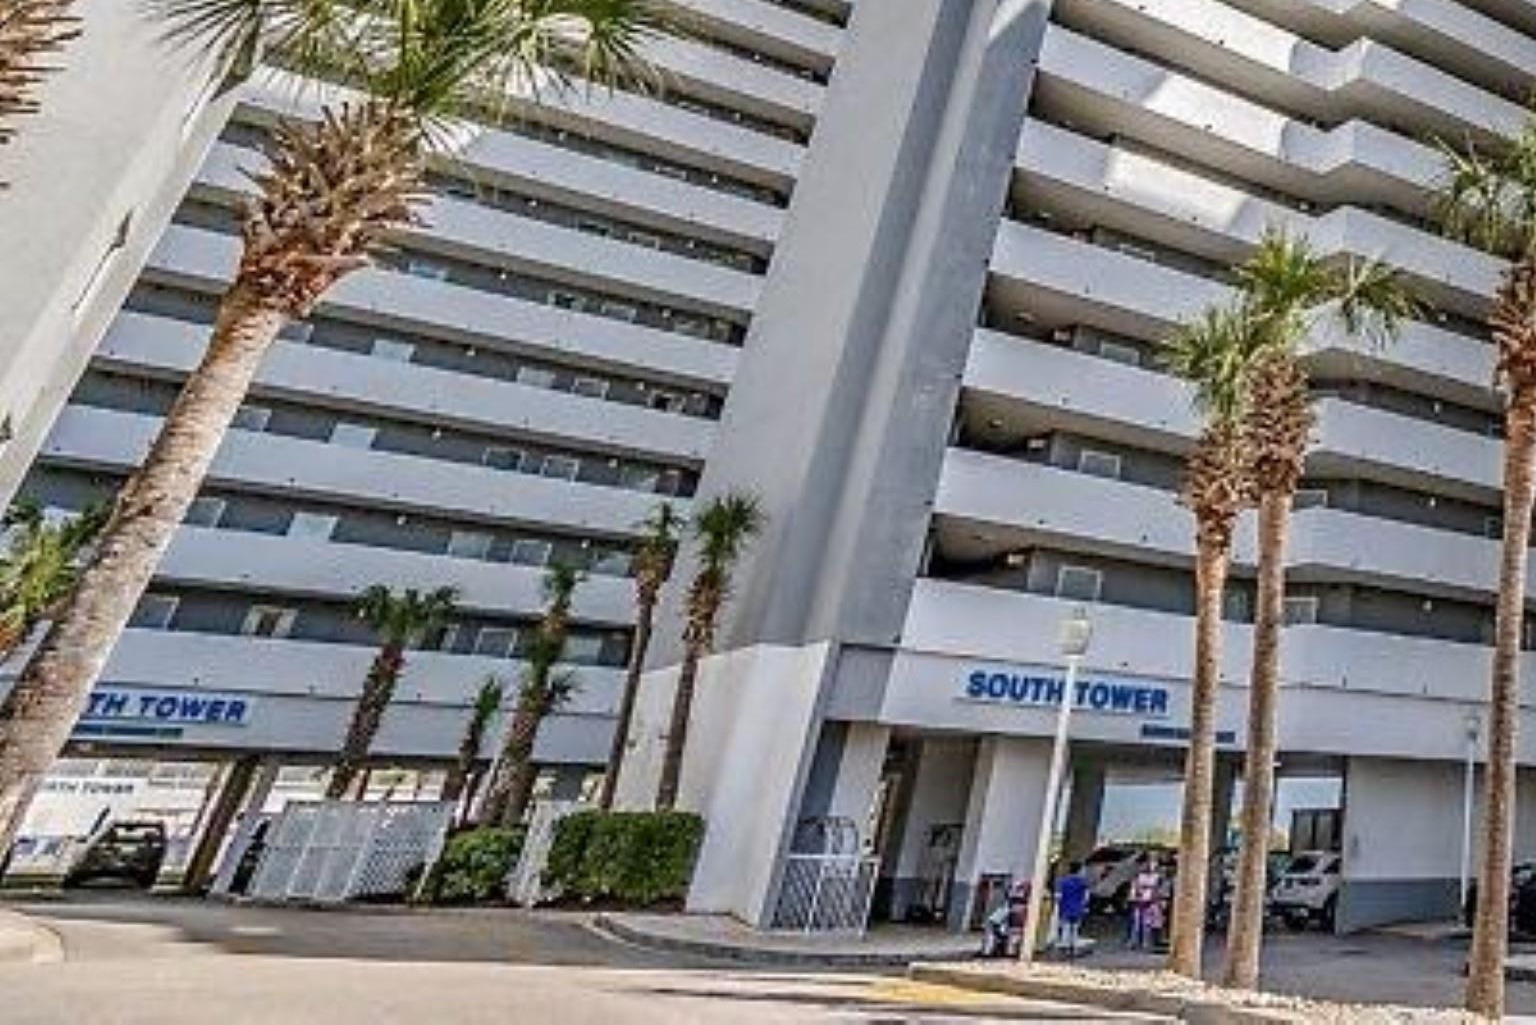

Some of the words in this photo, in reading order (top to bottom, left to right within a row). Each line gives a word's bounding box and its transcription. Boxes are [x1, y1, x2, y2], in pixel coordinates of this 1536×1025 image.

[967, 670, 1065, 702] SOUTH
[1074, 681, 1168, 712] TOWER
[139, 696, 247, 721] TOWER
